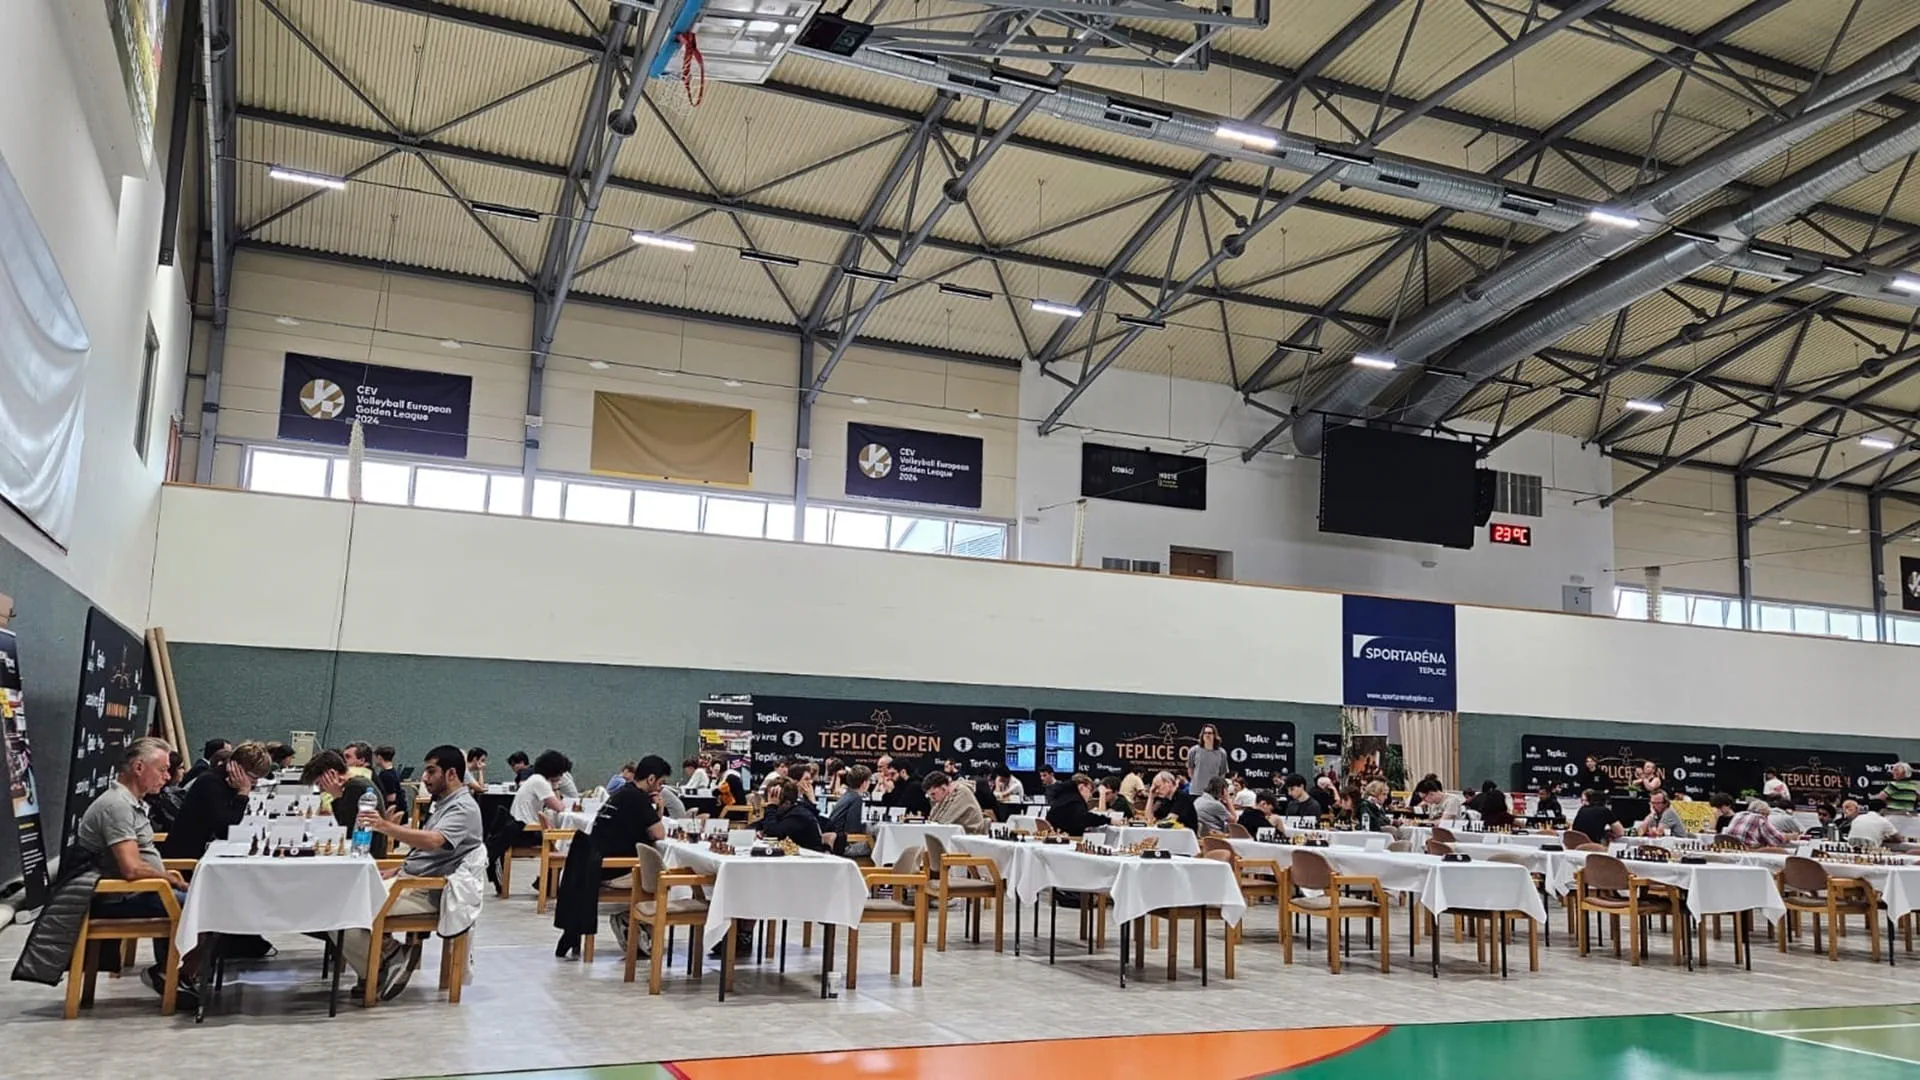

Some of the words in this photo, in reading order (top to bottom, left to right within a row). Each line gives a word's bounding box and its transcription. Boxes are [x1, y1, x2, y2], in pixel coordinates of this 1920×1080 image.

[356, 385, 378, 395] CEV
[356, 395, 405, 409] Volleyball
[406, 402, 452, 414] European
[355, 405, 395, 417] Golden
[393, 411, 429, 422] League
[355, 414, 379, 425] 2024
[899, 447, 916, 456] CEV
[899, 456, 935, 466] Volleyball
[936, 461, 970, 471] European
[899, 465, 926, 474] Golden
[926, 468, 953, 478] League
[899, 473, 918, 482] 2024
[1365, 647, 1447, 664] SPORTARÉNA
[1418, 666, 1447, 676] TEPLICE
[756, 713, 788, 723] Teplice
[970, 721, 1000, 733] Teplice
[761, 732, 778, 743] kraj
[818, 731, 888, 751] TEPLICE
[892, 734, 941, 753] OPEN
[1244, 733, 1271, 744] Teplice
[1115, 743, 1176, 761] TEPLICE
[1781, 772, 1821, 787] TEPLICE
